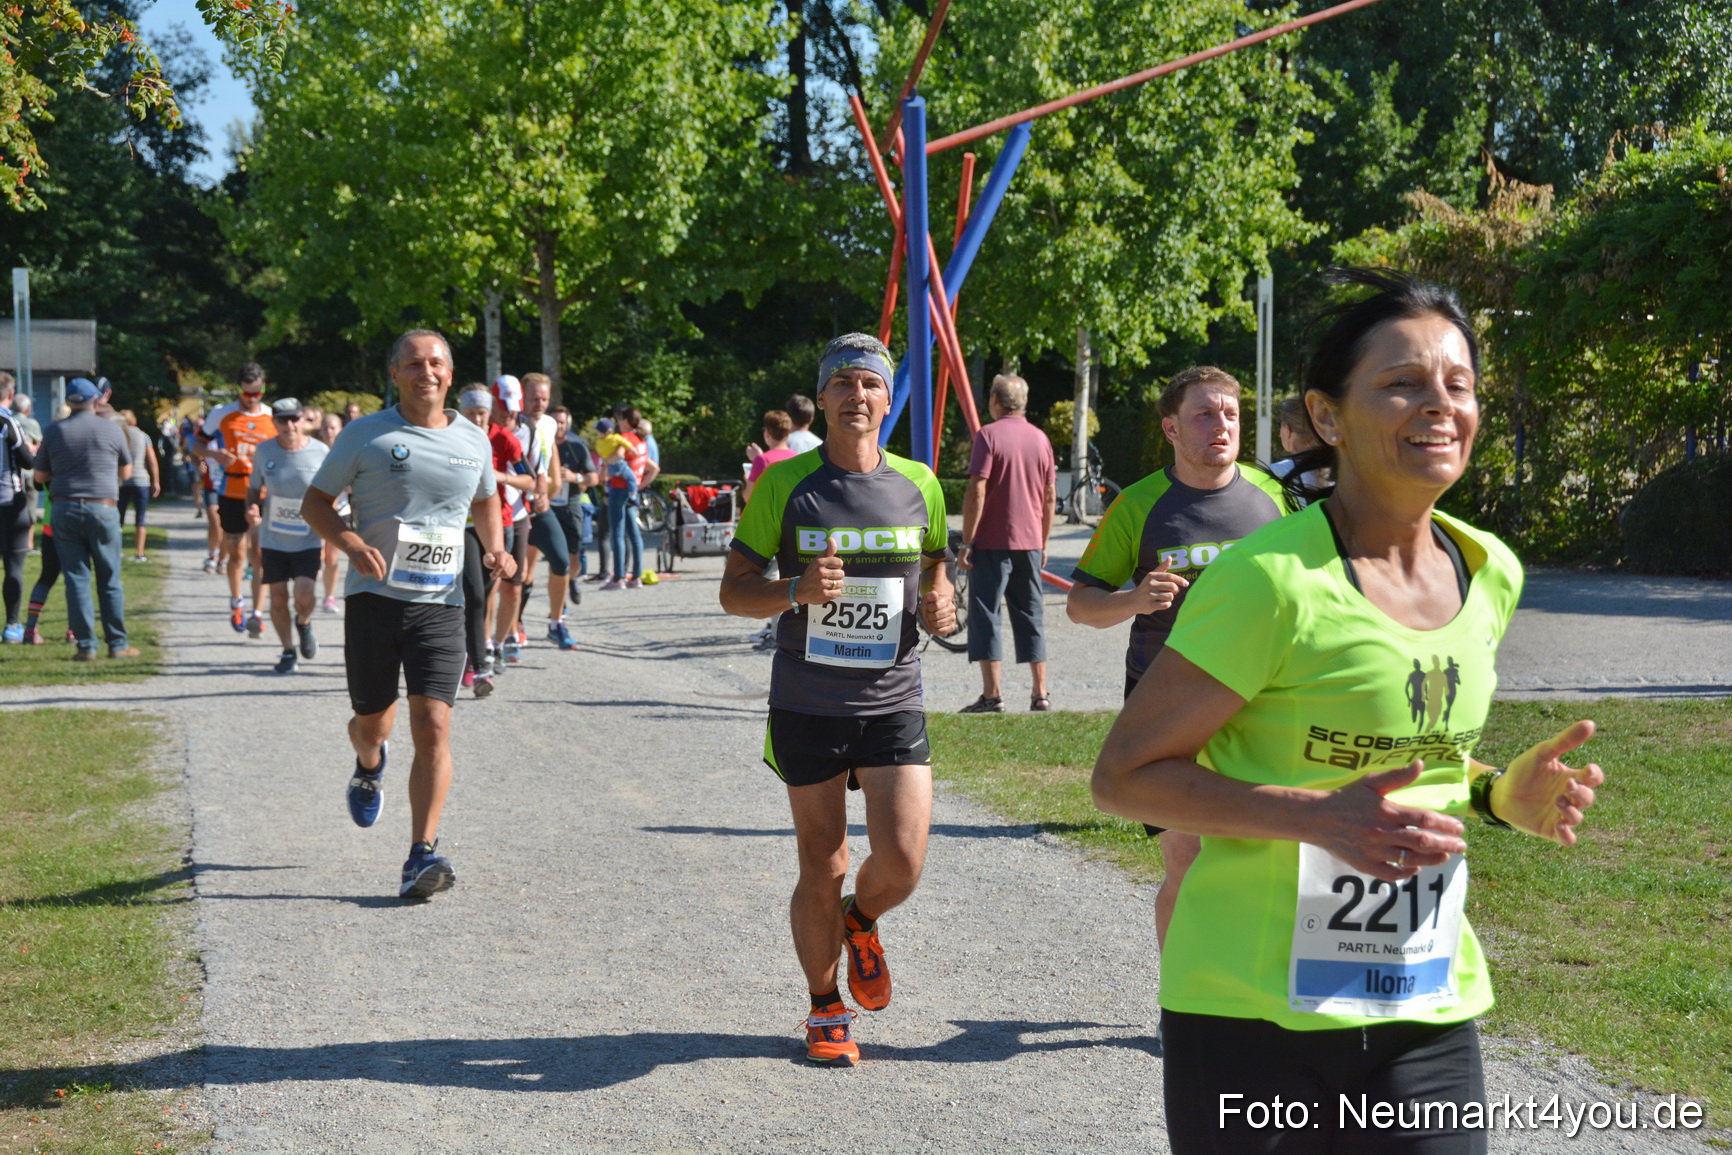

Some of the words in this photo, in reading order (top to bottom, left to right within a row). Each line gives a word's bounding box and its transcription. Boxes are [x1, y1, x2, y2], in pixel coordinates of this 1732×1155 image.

[798, 528, 921, 552] BOCK
[405, 543, 454, 565] 2266
[855, 554, 886, 564] smart
[821, 601, 889, 631] 2525
[825, 630, 846, 639] PARTL
[834, 644, 872, 658] Martin
[1308, 725, 1348, 746] SC
[1327, 873, 1444, 933] 2211
[1338, 941, 1380, 955] PARTL
[1383, 944, 1427, 956] Neumarkt
[1365, 968, 1416, 995] Ilona
